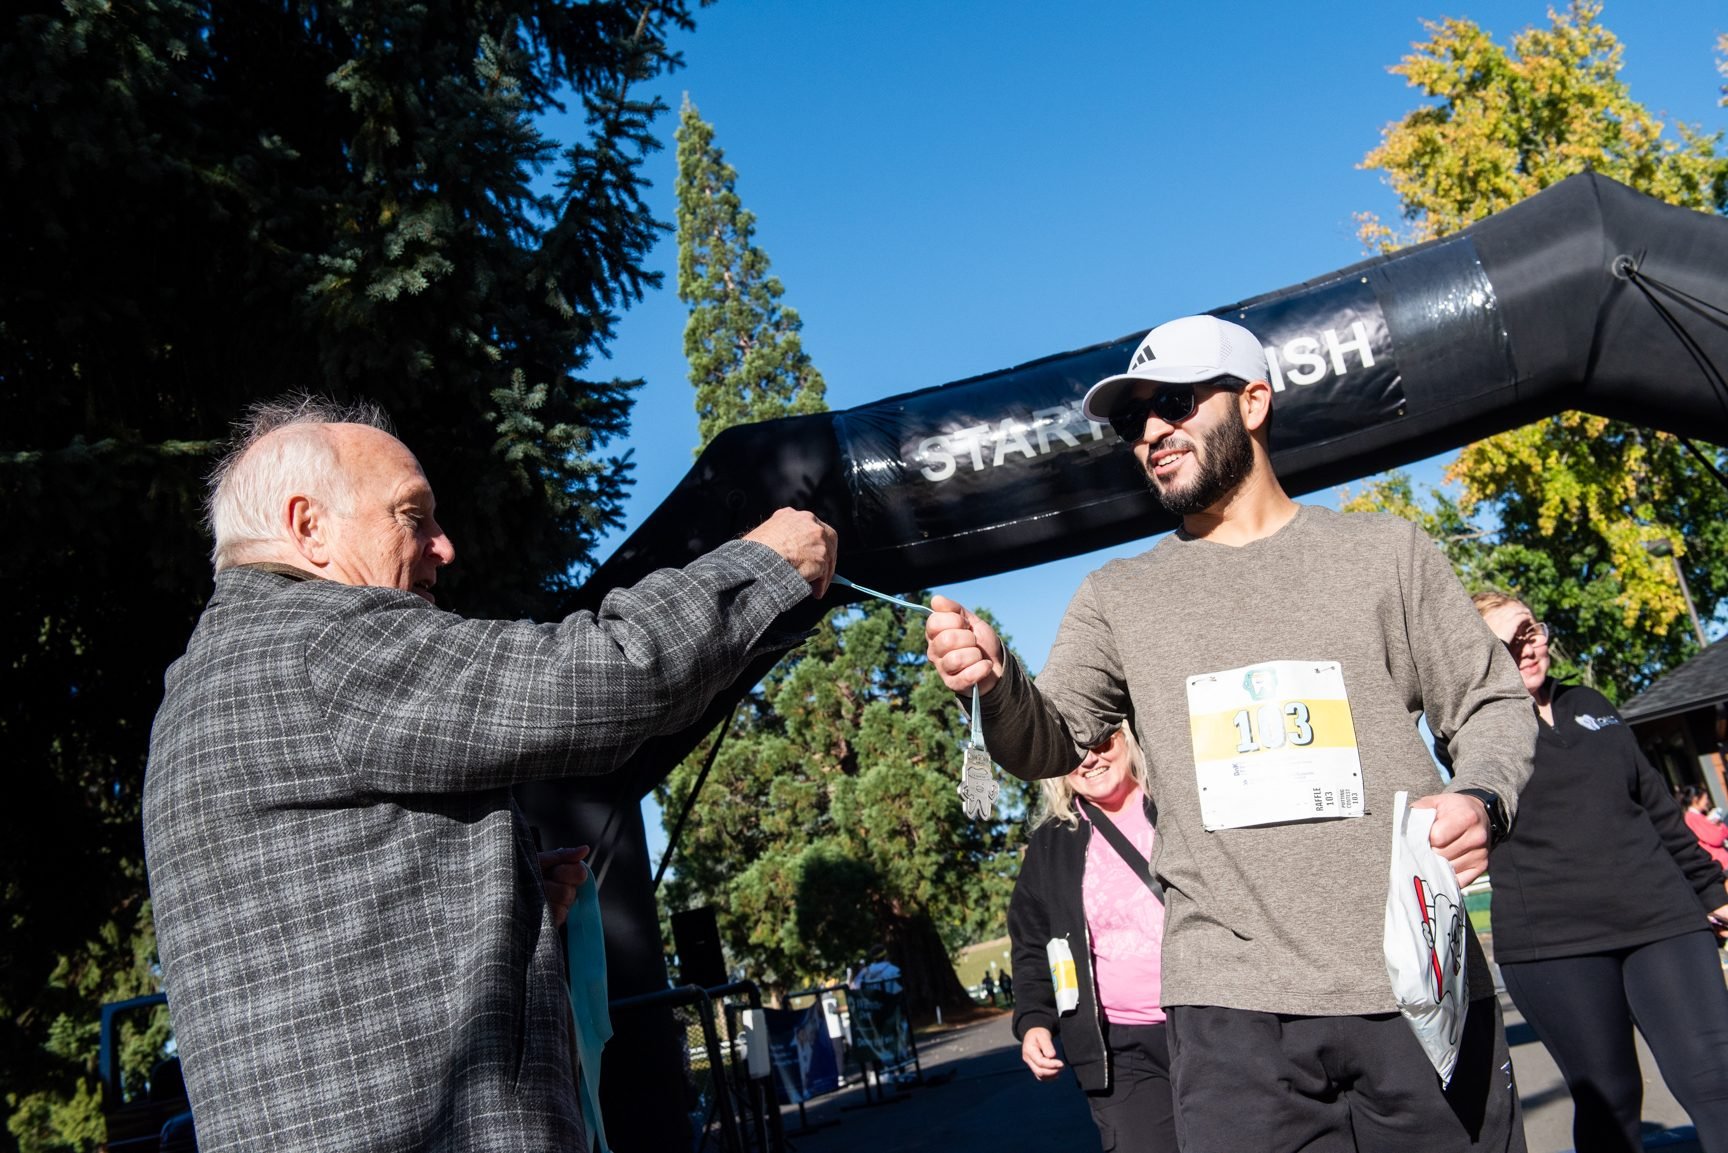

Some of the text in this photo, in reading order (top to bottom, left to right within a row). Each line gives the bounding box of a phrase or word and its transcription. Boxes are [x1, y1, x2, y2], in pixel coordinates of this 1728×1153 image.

[918, 321, 1375, 482] START ISH
[1233, 702, 1314, 754] 103
[1313, 787, 1324, 811] RAFFLE
[1325, 791, 1334, 806] 103
